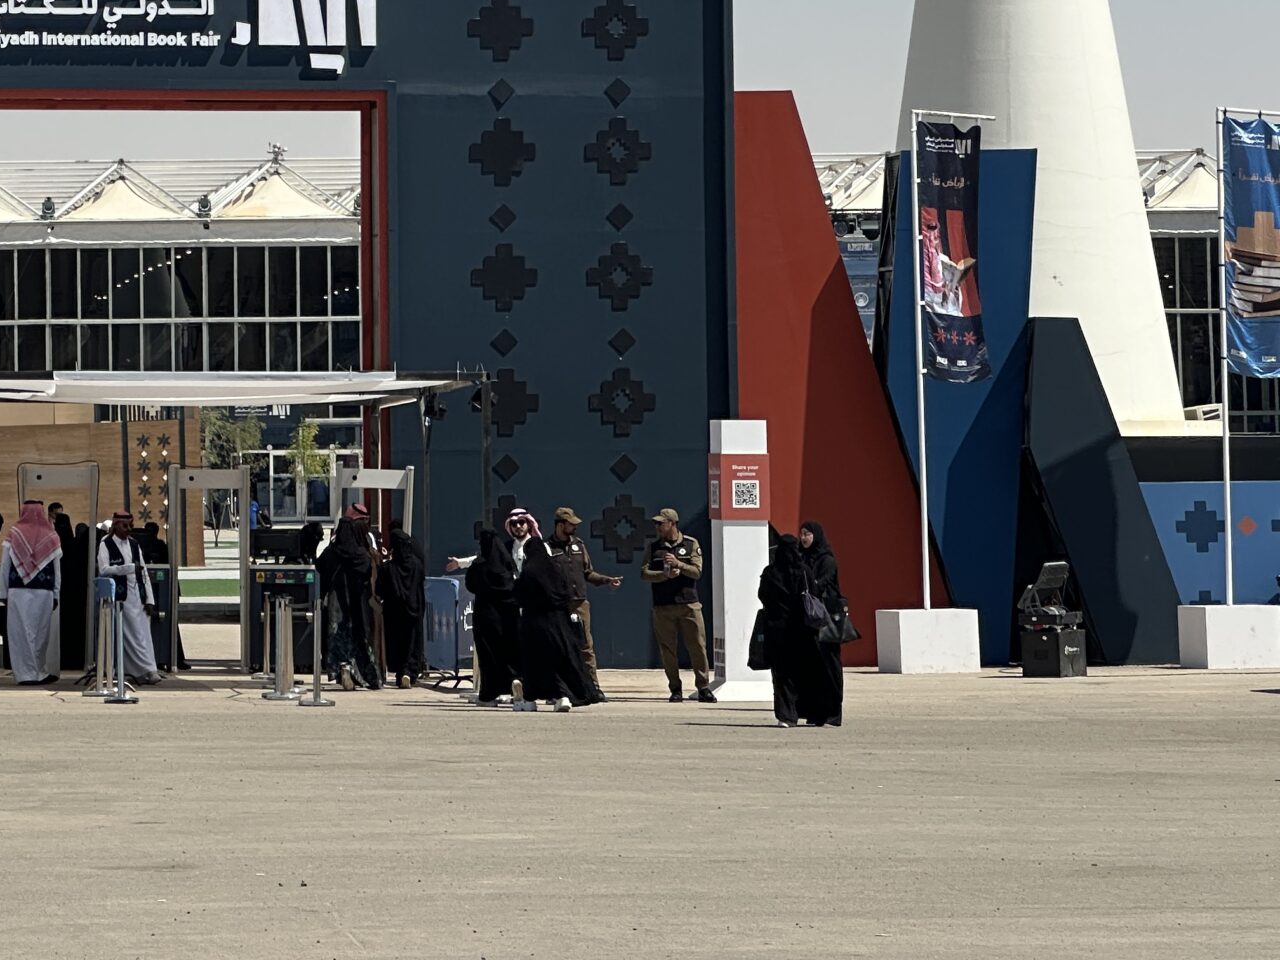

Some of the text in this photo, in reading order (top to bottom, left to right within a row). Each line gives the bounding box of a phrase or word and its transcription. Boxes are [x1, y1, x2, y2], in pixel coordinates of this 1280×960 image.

[42, 30, 144, 46] International
[147, 31, 188, 46] Book
[192, 31, 221, 46] Fair
